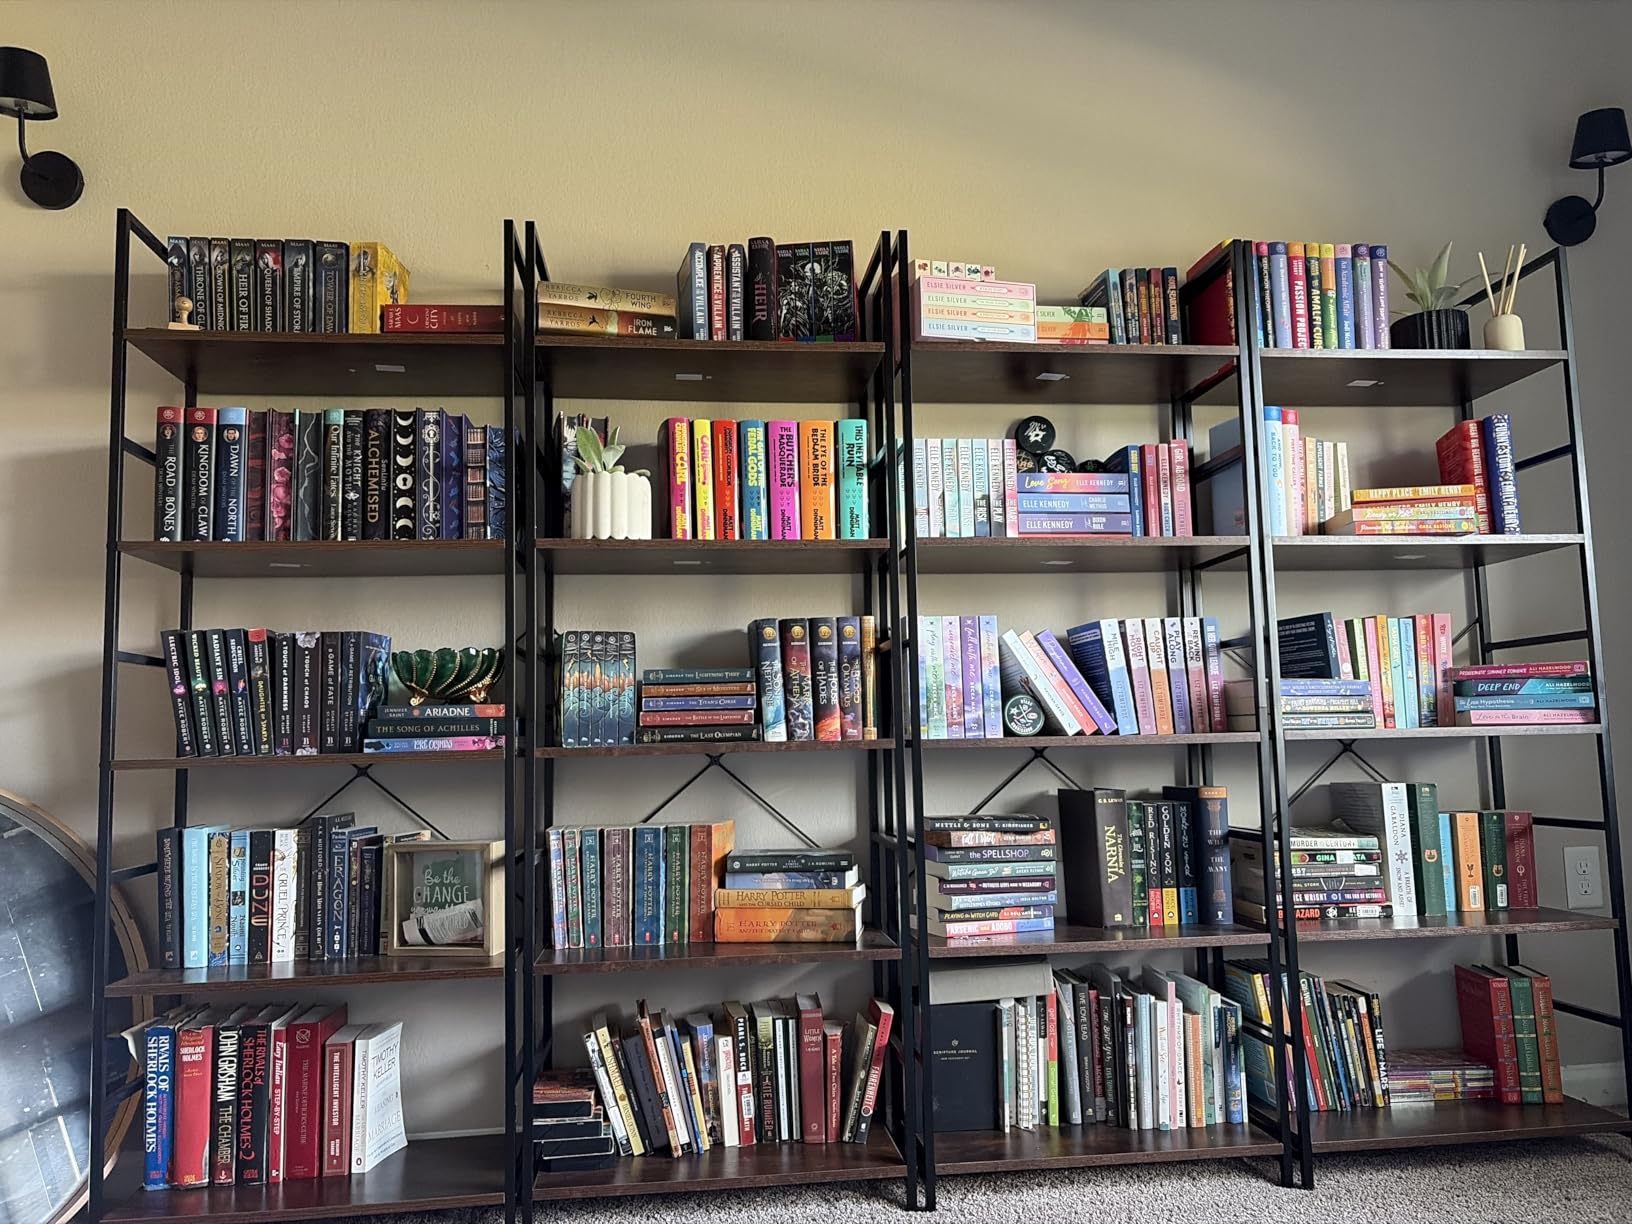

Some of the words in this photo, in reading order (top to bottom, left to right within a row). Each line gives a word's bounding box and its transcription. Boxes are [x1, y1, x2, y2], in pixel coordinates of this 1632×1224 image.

[196, 267, 204, 301] THRONE
[239, 274, 247, 297] HEIR
[264, 268, 272, 295] QUEEN
[545, 284, 582, 293] REBECCA
[945, 282, 966, 290] SILVER
[239, 299, 249, 311] OF
[626, 292, 656, 302] FOURTH
[631, 300, 652, 309] WING
[695, 295, 704, 324] VILLAIN
[752, 284, 768, 326] HEIR
[928, 295, 945, 303] ELSIE
[946, 296, 967, 304] SILVER
[1294, 280, 1304, 314] PASSION
[1311, 288, 1322, 324] AMALFI
[546, 310, 584, 318] REBECCA
[550, 320, 581, 328] YARROS
[634, 319, 652, 327] IRON
[713, 300, 722, 329] VILLAIN
[731, 297, 742, 329] VILLAIN
[628, 325, 657, 336] FLAME
[947, 324, 968, 332] SILVER
[811, 428, 819, 462] BEDLAM
[855, 425, 863, 439] THIS
[229, 445, 239, 477] DAWN
[778, 434, 786, 487] MASQUERADE
[786, 434, 795, 488] BUTCHER'S
[821, 461, 827, 471] OF
[845, 443, 855, 467] RUN
[856, 441, 864, 486] INEVITABLE
[1174, 448, 1183, 463] GIRL
[165, 456, 176, 487] ROAD
[198, 444, 209, 496] KINGDOM
[367, 430, 380, 523] ALCHEMISED
[748, 457, 757, 486] GODS
[812, 463, 820, 487] BRIDE
[1024, 476, 1044, 489] Love
[1089, 479, 1113, 487] KENNEDY
[1474, 477, 1483, 486] LIFE
[1023, 500, 1040, 508] ELLE
[1042, 500, 1069, 509] KENNEDY
[1369, 489, 1390, 497] HAPPY
[1392, 488, 1413, 497] PLACE
[1418, 487, 1439, 495] EMILY
[1442, 487, 1462, 495] HENRY
[1476, 493, 1486, 516] EMILY
[164, 496, 176, 532] BONES
[197, 506, 208, 537] CLAW
[227, 498, 236, 535] NORTH
[977, 507, 987, 521] RISK
[1026, 520, 1042, 529] ELLE
[1043, 520, 1073, 529] KENNEDY
[1111, 633, 1119, 653] MILE
[1149, 642, 1156, 653] UP
[1154, 630, 1163, 664] CAUGHT
[1168, 634, 1177, 663] ALONG
[1174, 631, 1182, 651] PLAY
[1192, 630, 1201, 663] REWIND
[762, 661, 774, 707] NEPTUNE
[790, 669, 800, 708] ATHENA
[816, 672, 827, 705] HADES
[828, 673, 838, 705] HOUSE
[842, 663, 851, 708] OLYMPUS
[1478, 683, 1500, 692] DEEP
[1503, 683, 1520, 691] END
[425, 707, 470, 716] ARIADNE
[376, 725, 395, 733] THE
[397, 725, 422, 733] SONG
[437, 724, 480, 732] ACHILLES
[1161, 806, 1170, 849] GOLDEN
[1179, 806, 1189, 848] MORNING
[1390, 806, 1399, 846] GABALDON
[982, 850, 1029, 858] SPELLSHOP
[1104, 826, 1119, 884] NARNIA
[1149, 832, 1157, 875] RISING
[1164, 852, 1172, 874] SON
[1183, 853, 1194, 878] STAR
[278, 872, 287, 904] CRUEL
[333, 855, 345, 921] ERAGON
[425, 869, 441, 885] Be
[443, 867, 461, 883] the
[252, 874, 268, 926] DUNE
[414, 885, 469, 903] CHANGE
[736, 891, 768, 901] HARRY
[771, 891, 806, 901] POTTER
[1305, 894, 1327, 902] WRIGHT
[277, 906, 289, 941] PRINCE
[218, 1030, 238, 1056] JOHN
[804, 1035, 821, 1043] WOMEN
[1375, 1028, 1383, 1050] LIFE
[159, 1035, 169, 1072] RIVALS
[242, 1038, 255, 1096] SHERLOCK
[146, 1036, 158, 1099] SHERLOCK
[217, 1058, 237, 1102] GRISHAM
[374, 1057, 396, 1080] KELLER
[606, 1055, 623, 1090] ISHMAEL
[1378, 1062, 1388, 1090] MARS
[159, 1076, 169, 1091] OF
[762, 1081, 772, 1098] KITE
[863, 1066, 880, 1108] FAHRENHEIT
[146, 1103, 156, 1153] HOLMES
[219, 1105, 232, 1124] THE
[240, 1100, 252, 1150] HOLMES
[764, 1099, 774, 1130] RUNNER
[217, 1126, 232, 1166] CHAMBER
[240, 1151, 256, 1160] 2
